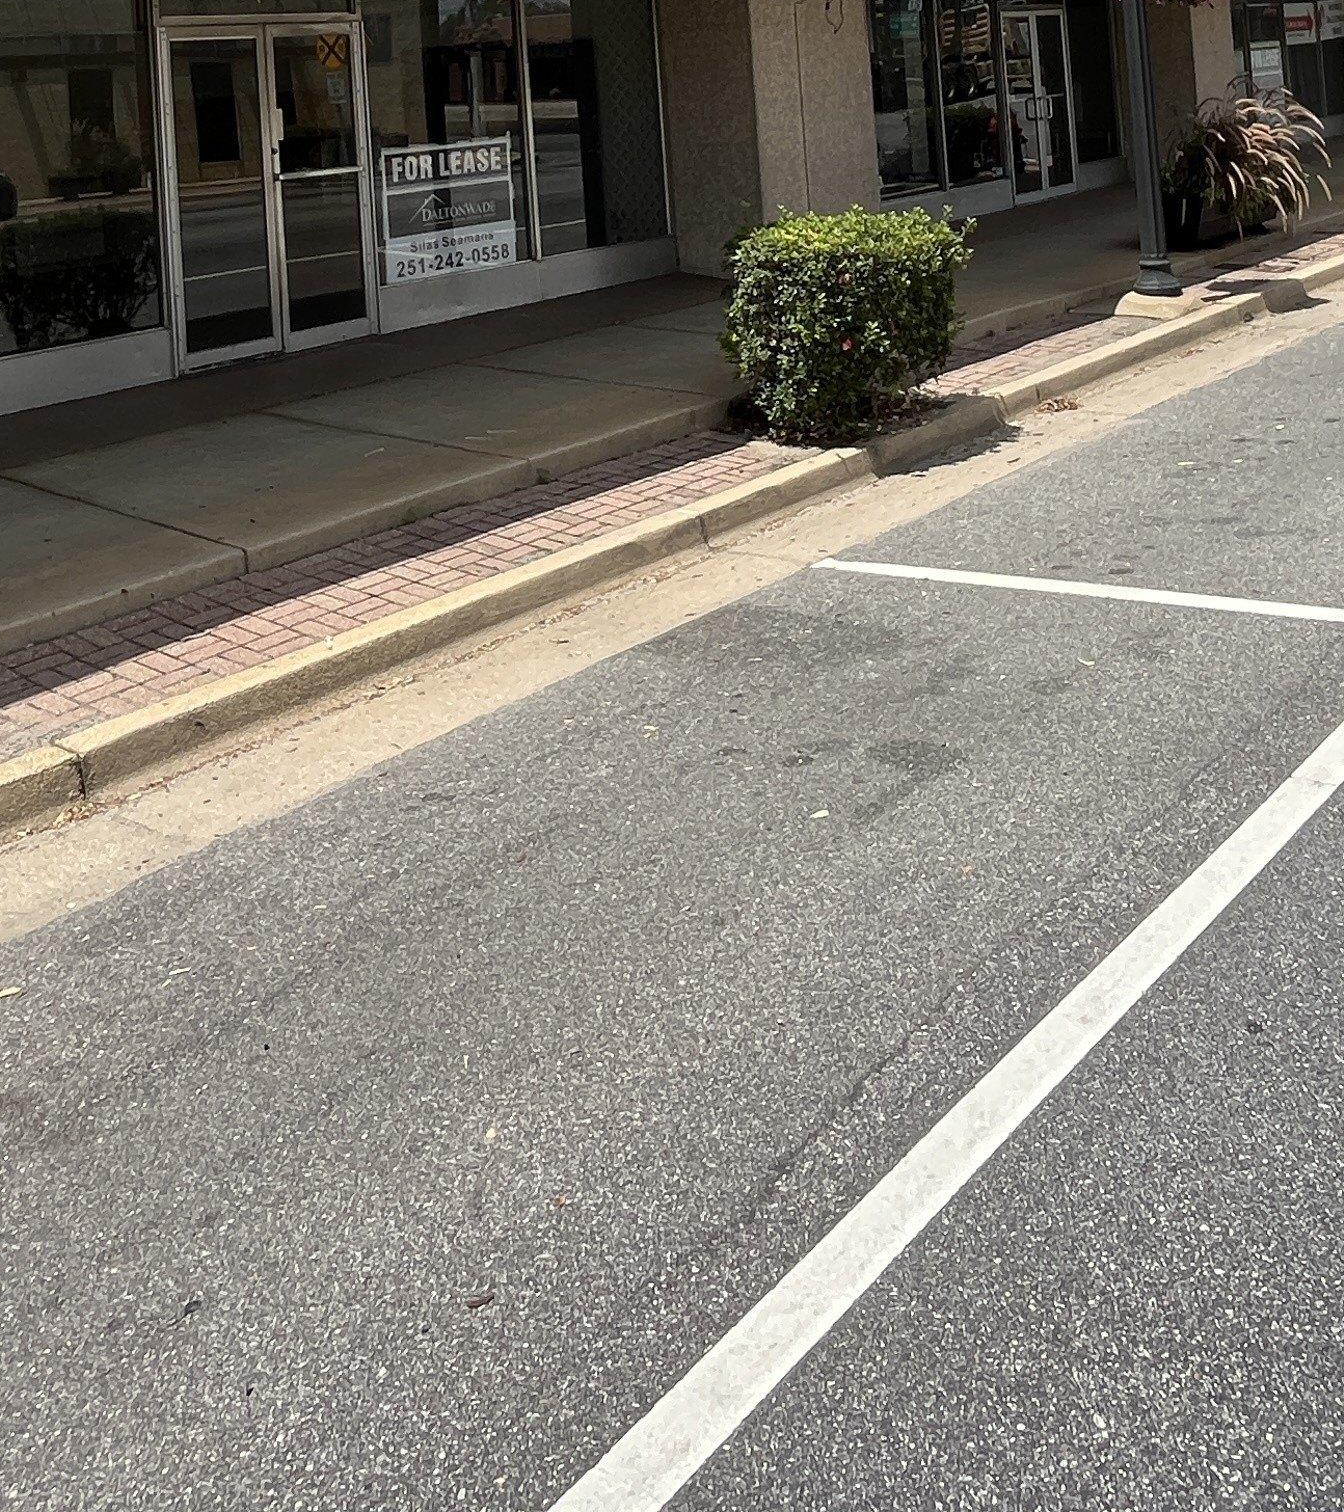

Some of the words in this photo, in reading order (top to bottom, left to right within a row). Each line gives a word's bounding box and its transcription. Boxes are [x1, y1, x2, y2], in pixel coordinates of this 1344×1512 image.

[391, 154, 433, 183] FOR
[438, 147, 502, 176] LEASE
[396, 242, 510, 278] 251-242-0558
